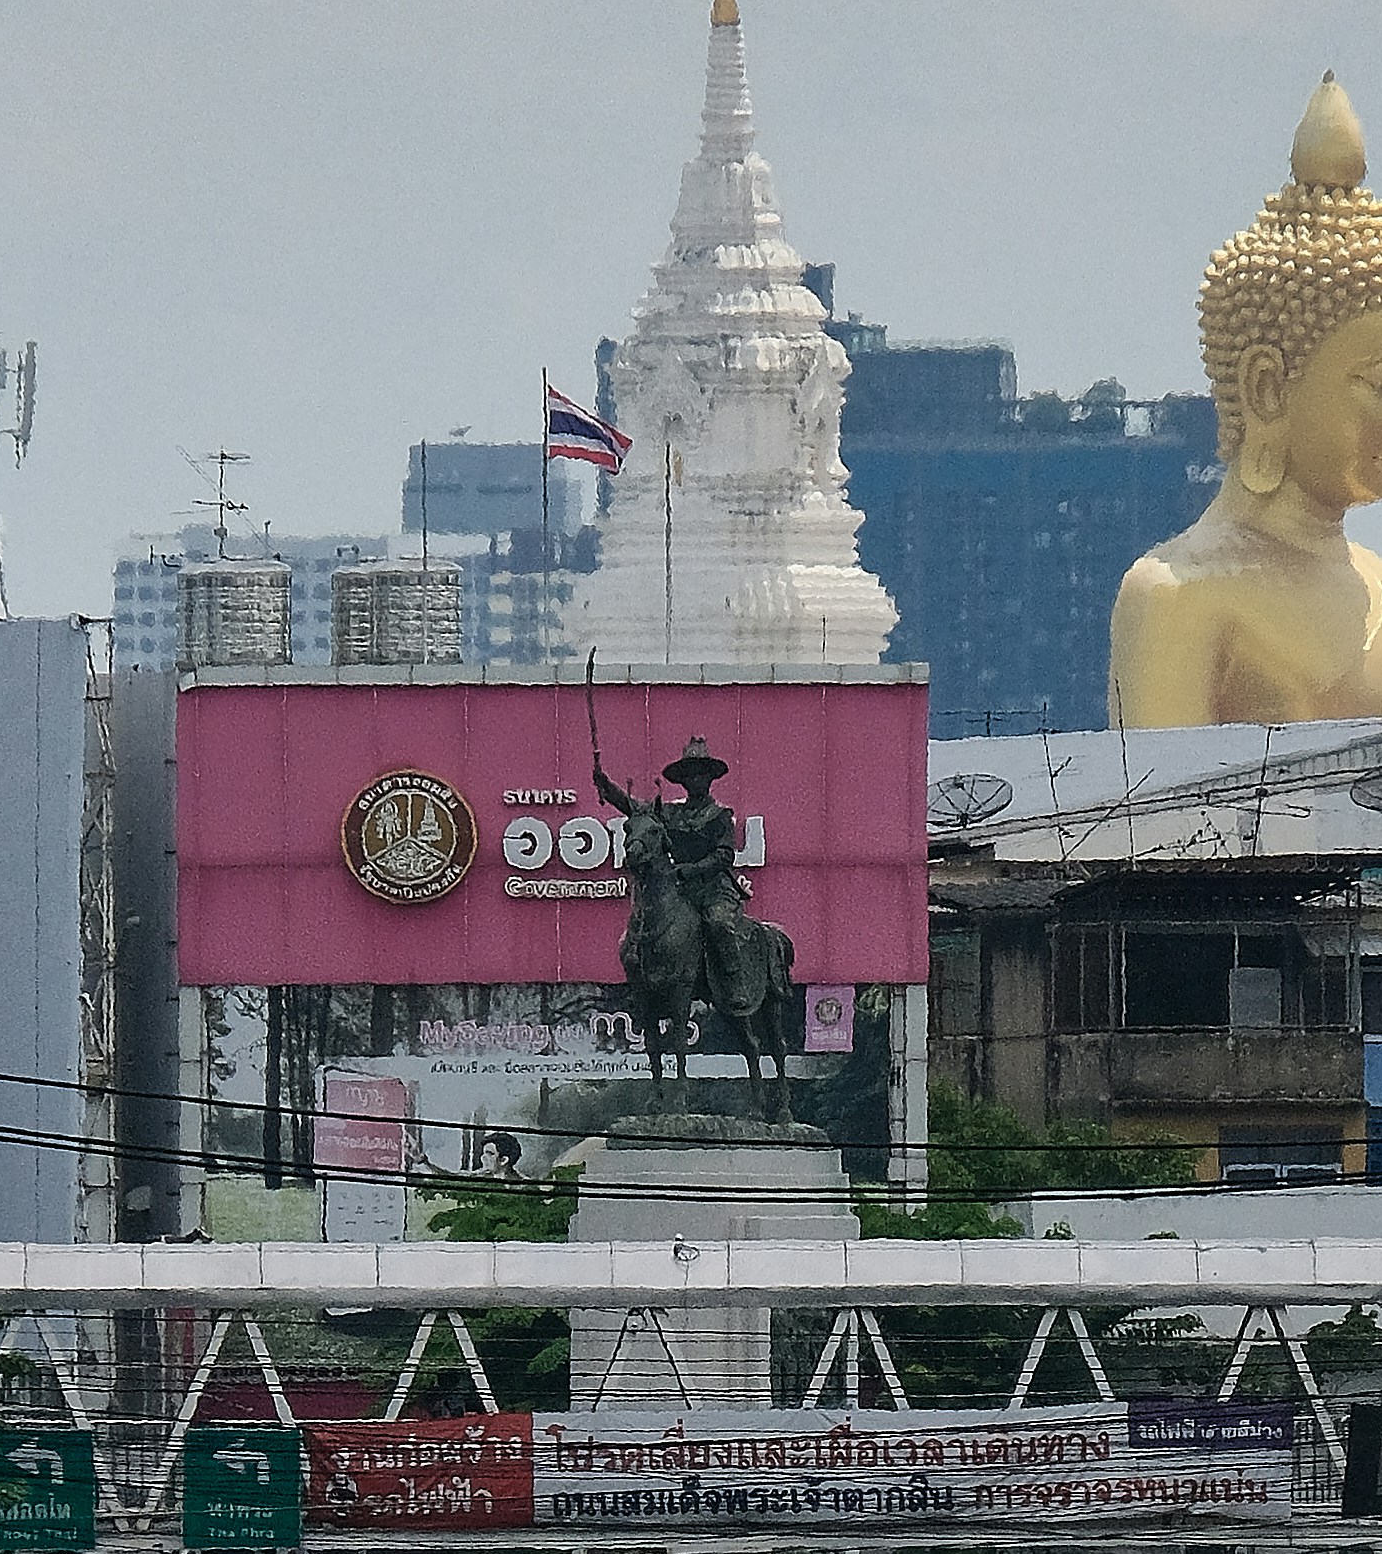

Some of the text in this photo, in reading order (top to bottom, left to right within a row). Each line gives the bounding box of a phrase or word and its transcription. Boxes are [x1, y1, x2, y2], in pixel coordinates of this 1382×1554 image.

[502, 787, 578, 805] ธนาคาร
[504, 875, 628, 899] Government
